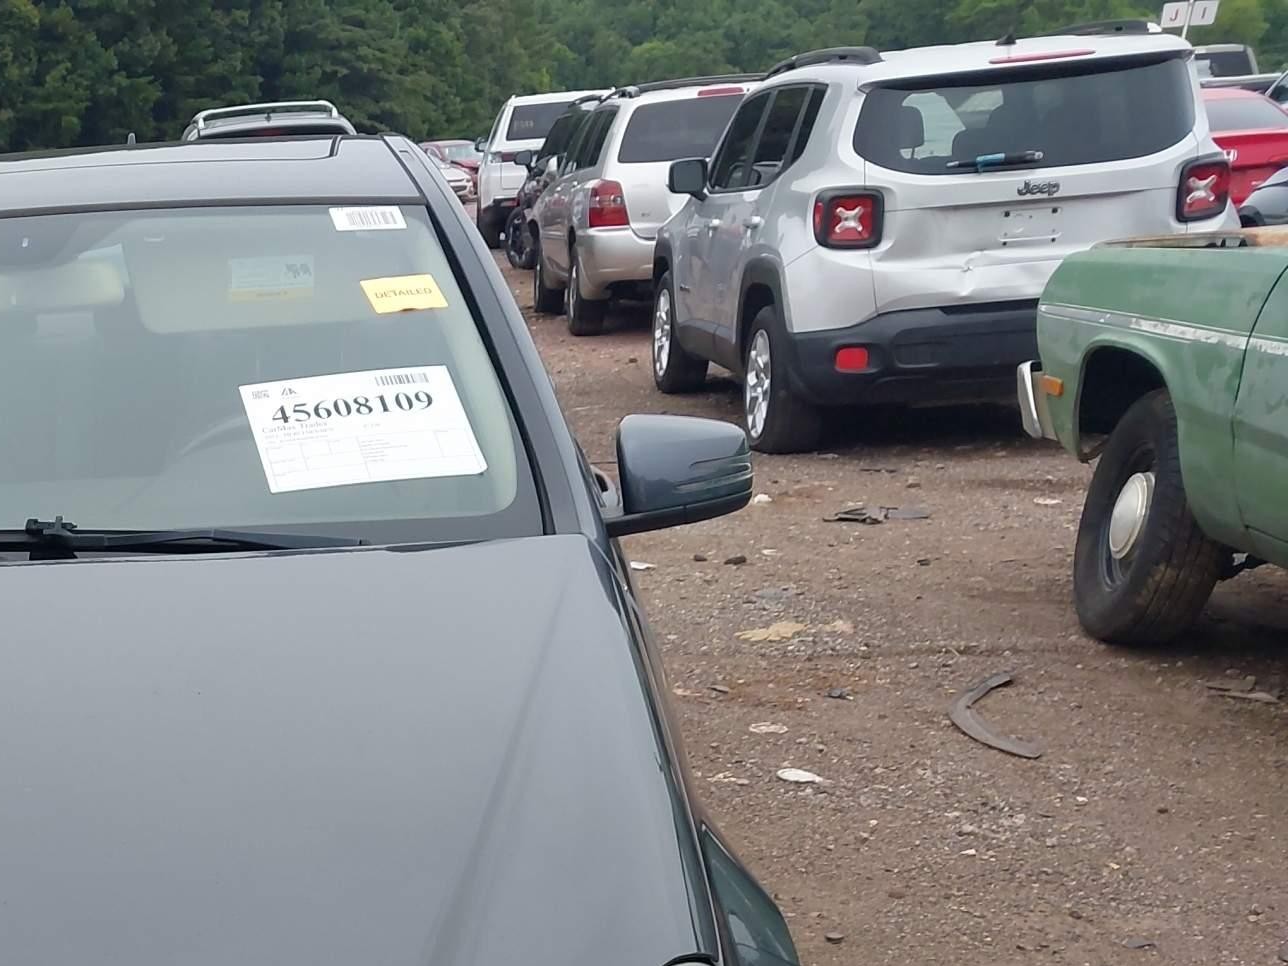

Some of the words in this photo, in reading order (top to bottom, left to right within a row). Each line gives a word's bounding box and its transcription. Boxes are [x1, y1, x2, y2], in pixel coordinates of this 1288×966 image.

[1169, 8, 1179, 21] J
[1017, 180, 1060, 196] Jeep
[374, 286, 433, 299] DETAILED
[271, 390, 434, 424] 45608109
